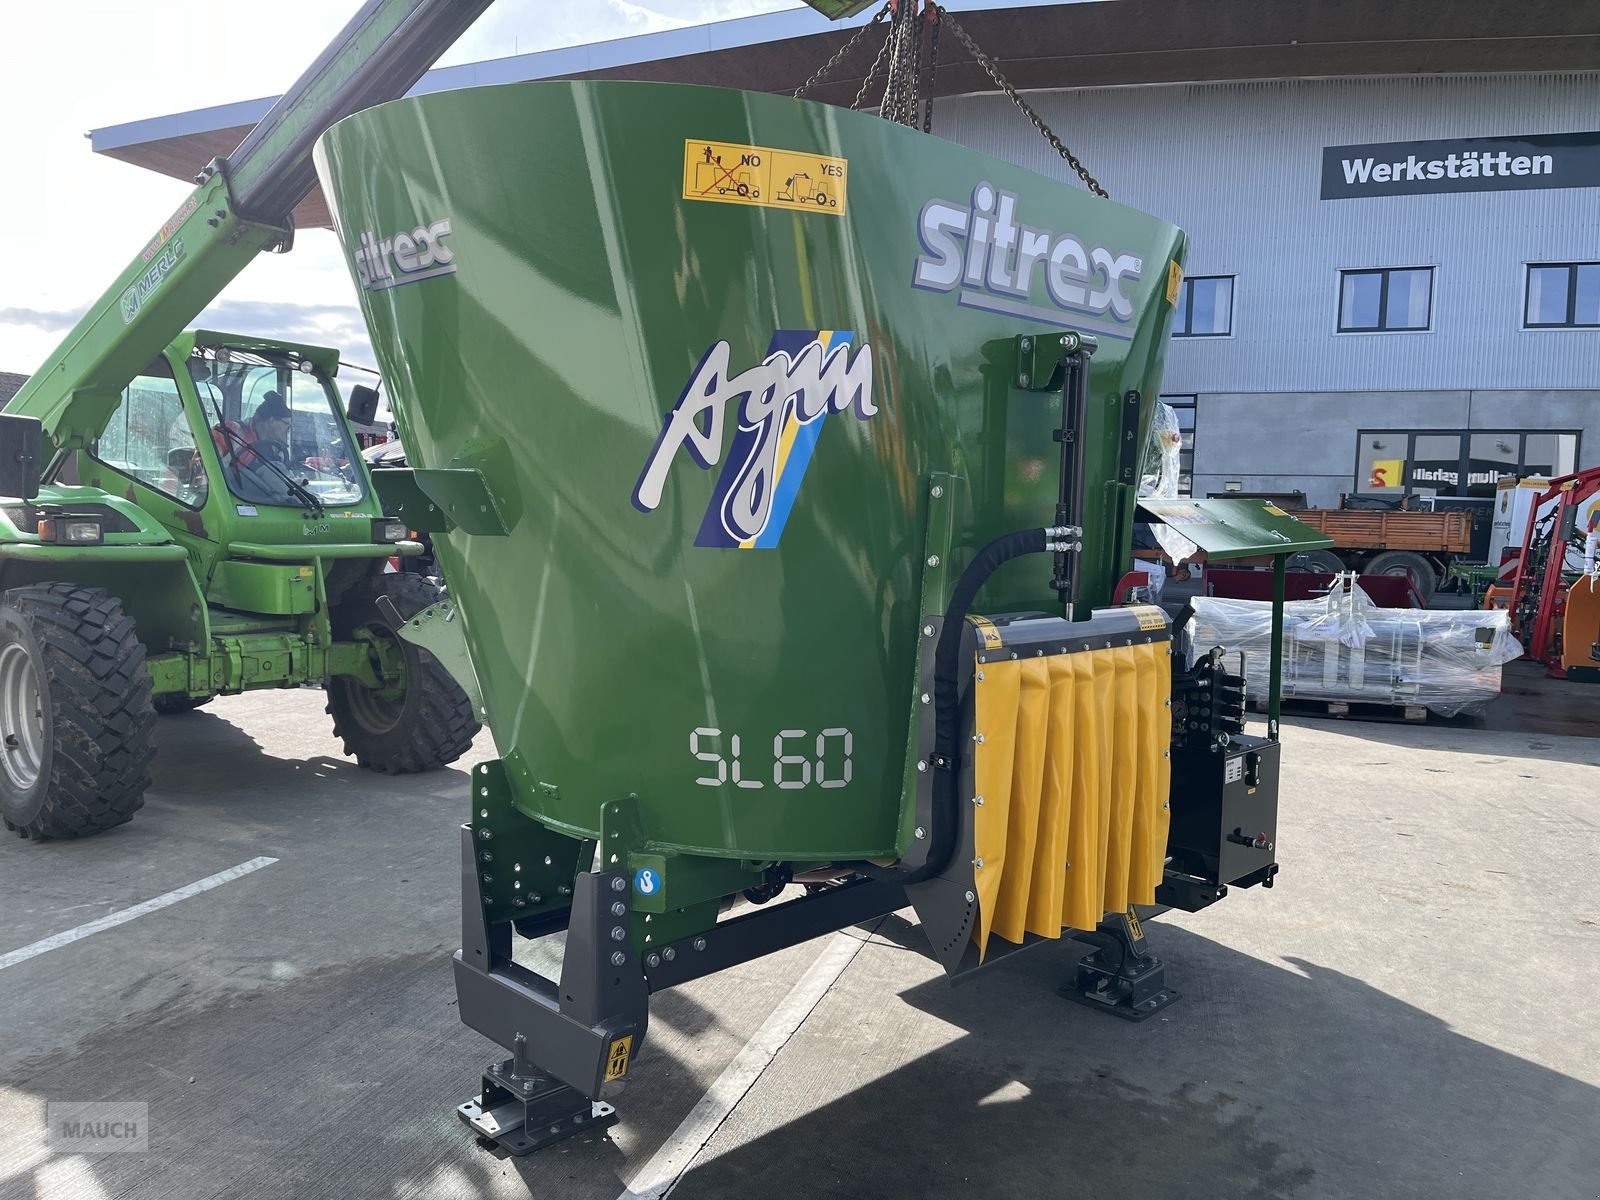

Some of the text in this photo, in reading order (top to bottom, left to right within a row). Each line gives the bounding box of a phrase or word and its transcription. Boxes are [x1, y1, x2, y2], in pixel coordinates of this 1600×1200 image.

[741, 153, 761, 167] NO
[820, 163, 843, 177] YES
[1341, 151, 1553, 184] Werkstätten
[354, 218, 454, 289] sitrex
[914, 181, 1143, 320] sitrex
[689, 727, 853, 789] SL60
